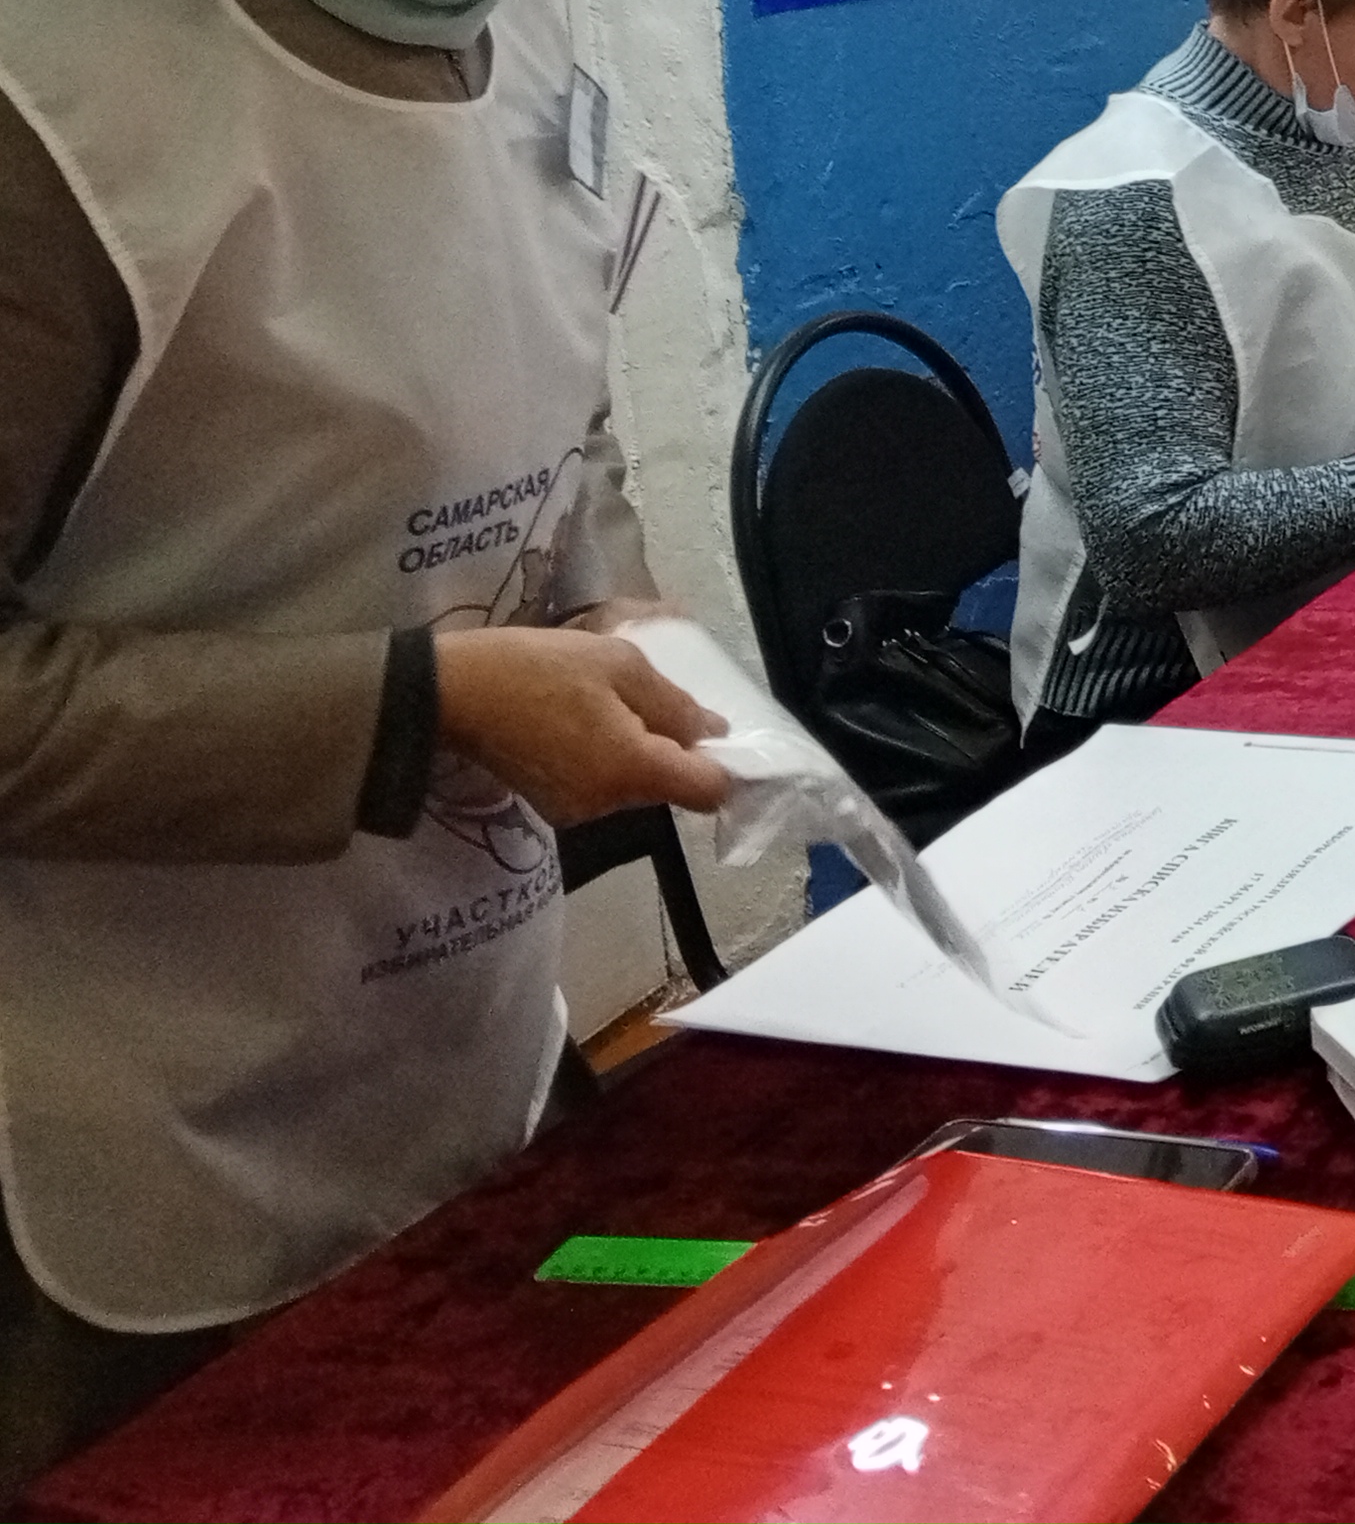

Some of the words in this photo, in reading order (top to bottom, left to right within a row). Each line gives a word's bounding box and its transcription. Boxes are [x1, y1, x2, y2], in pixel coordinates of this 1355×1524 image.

[406, 468, 551, 537] САМАРСКАЯ
[399, 519, 520, 574] ОБЛАСТЬ
[1184, 818, 1238, 853] КНИГА
[1122, 852, 1188, 903] СПИСКА
[1218, 881, 1254, 908] МАРТА
[1257, 854, 1317, 904] ПРЕЗИДЕНТА
[1008, 903, 1129, 992] ИЗБИРАТЕЛЕЙ
[1193, 903, 1262, 955] РОССИЙСКОЙ
[1134, 955, 1195, 1010] ФЕДЕРАЦИИ
